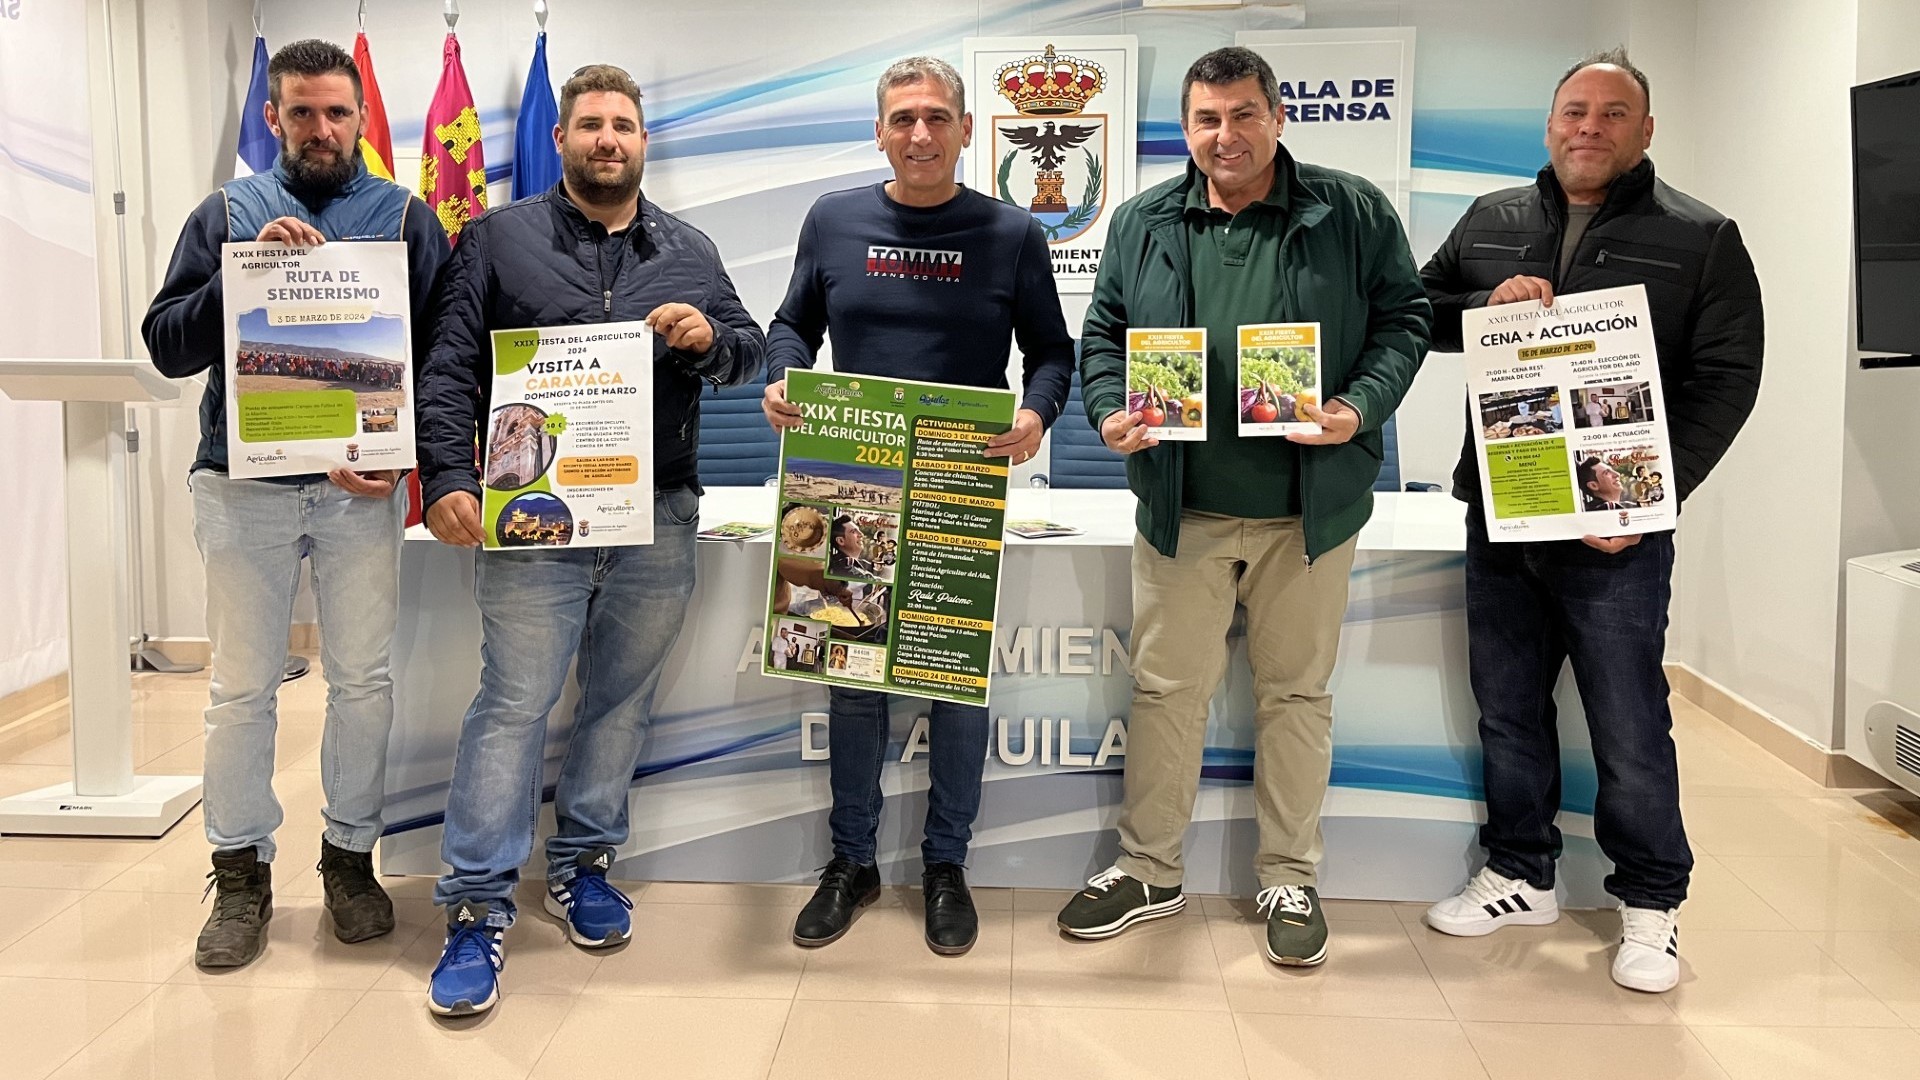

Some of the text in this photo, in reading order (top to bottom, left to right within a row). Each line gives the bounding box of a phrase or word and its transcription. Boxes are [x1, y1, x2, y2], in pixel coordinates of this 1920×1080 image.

[1279, 79, 1394, 99] ALA DE
[1285, 103, 1391, 122] RENSA
[872, 248, 959, 275] TOMMY
[1052, 264, 1098, 274] UILAS
[286, 271, 360, 283] RUTA DE
[267, 288, 379, 300] SENDERISMO
[300, 314, 327, 322] MARZO
[1488, 300, 1624, 325] XXIX FIESTA DEL AGRICULTOR
[1480, 331, 1522, 347] CENA
[1540, 314, 1638, 340] ACTUACIÓN
[537, 338, 566, 346] FIESTA
[586, 332, 640, 342] AGRICULTOR
[1540, 346, 1562, 355] MARZO
[1574, 343, 1592, 351] 2024
[527, 358, 600, 374] VISITA A
[1598, 354, 1628, 363] ELECCIÓN
[1573, 364, 1612, 373] AGRICULTOR
[526, 372, 624, 390] CARAVACA
[1492, 374, 1515, 382] MARINA
[525, 390, 570, 400] DOMINGO
[602, 387, 636, 395] MARZO
[843, 407, 907, 431] FIESTA
[917, 419, 975, 430] ACTIVIDADES
[818, 424, 906, 447] AGRICULTOR
[918, 430, 951, 438] DOMINGO
[1613, 429, 1650, 437] ACTUACIÓN
[855, 445, 904, 467] 2024
[913, 492, 947, 501] DOMINGO
[970, 499, 994, 507] MARZO
[909, 532, 939, 541] SÁBADO
[962, 539, 987, 547] MARZO
[908, 589, 935, 602] Raúl
[902, 612, 934, 622] DOMINGO
[958, 620, 982, 628] MARZO
[896, 668, 928, 678] DOMINGO
[952, 675, 977, 684] MARZO
[802, 712, 830, 760] D
